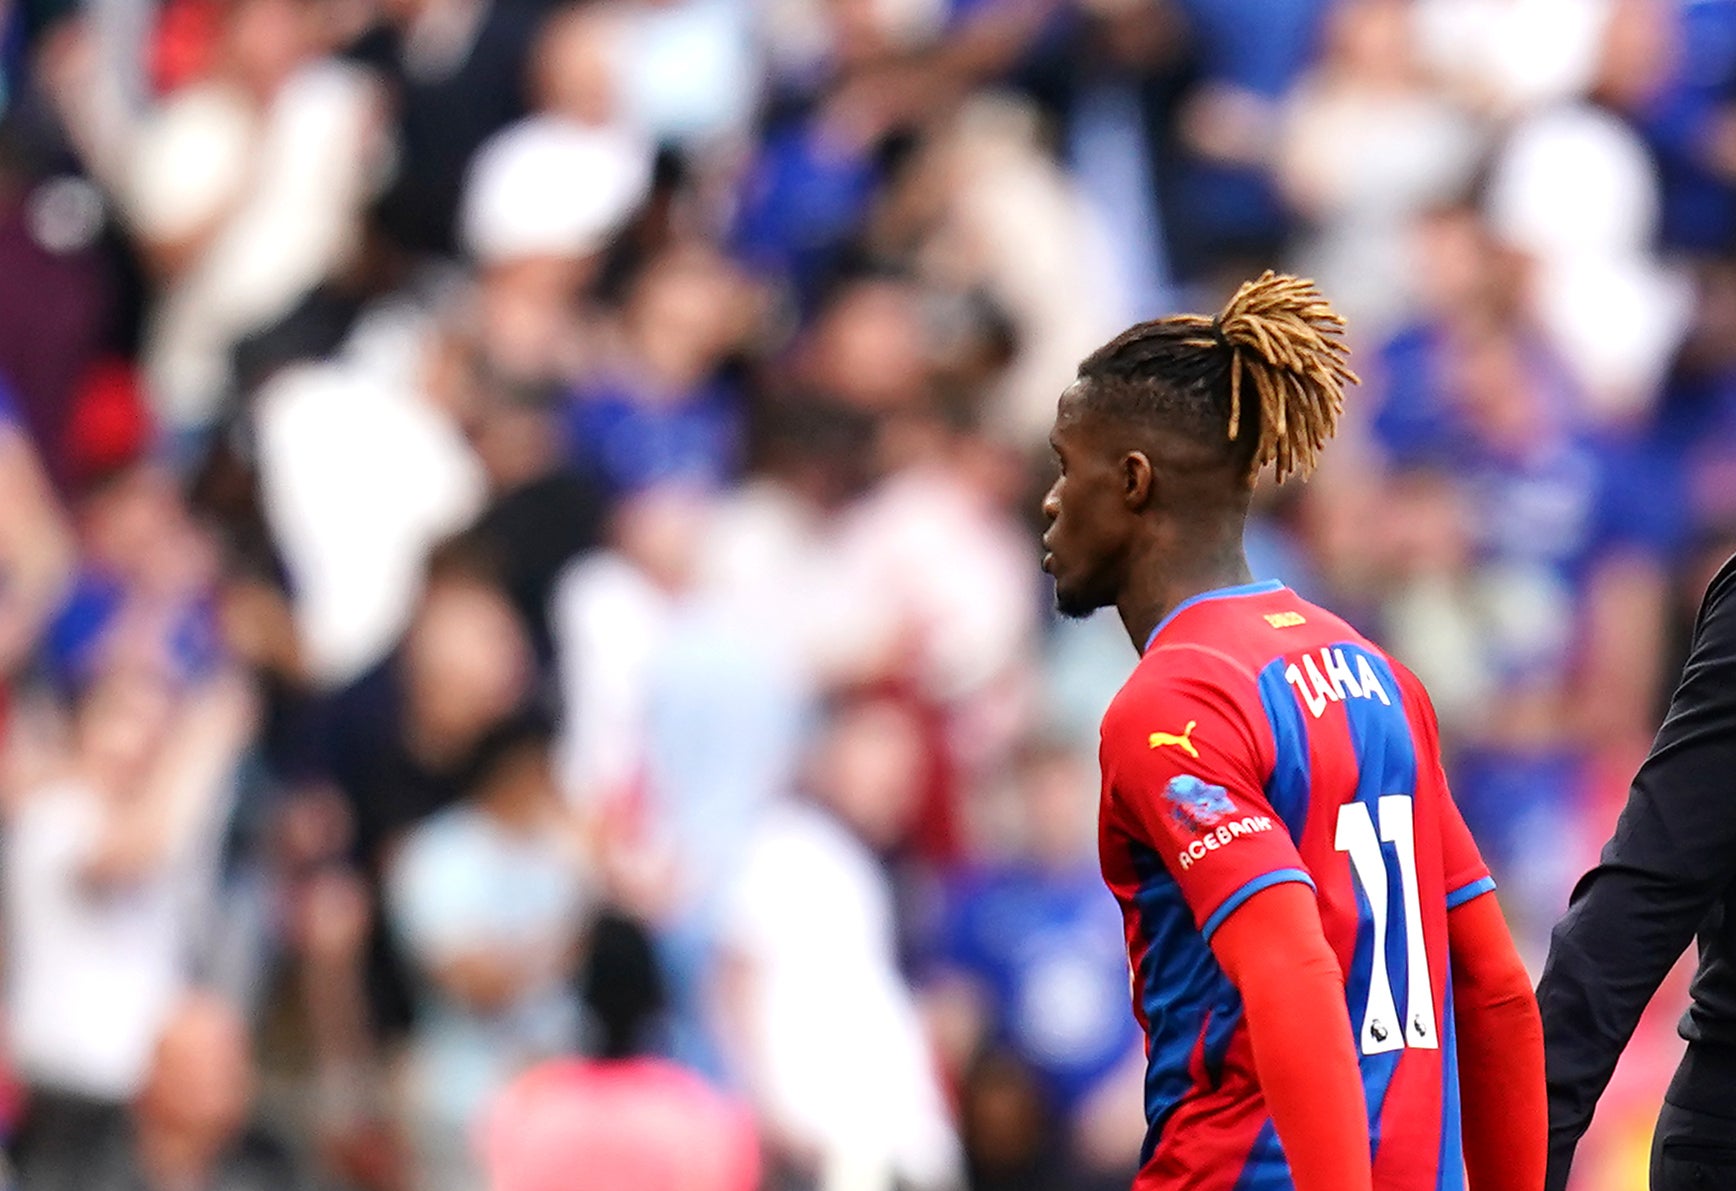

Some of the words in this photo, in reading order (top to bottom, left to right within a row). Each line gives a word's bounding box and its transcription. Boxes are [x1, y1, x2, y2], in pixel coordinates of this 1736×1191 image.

[1284, 647, 1391, 718] ZAHA
[1178, 816, 1273, 870] ACEBANK
[1334, 794, 1439, 1055] 11
